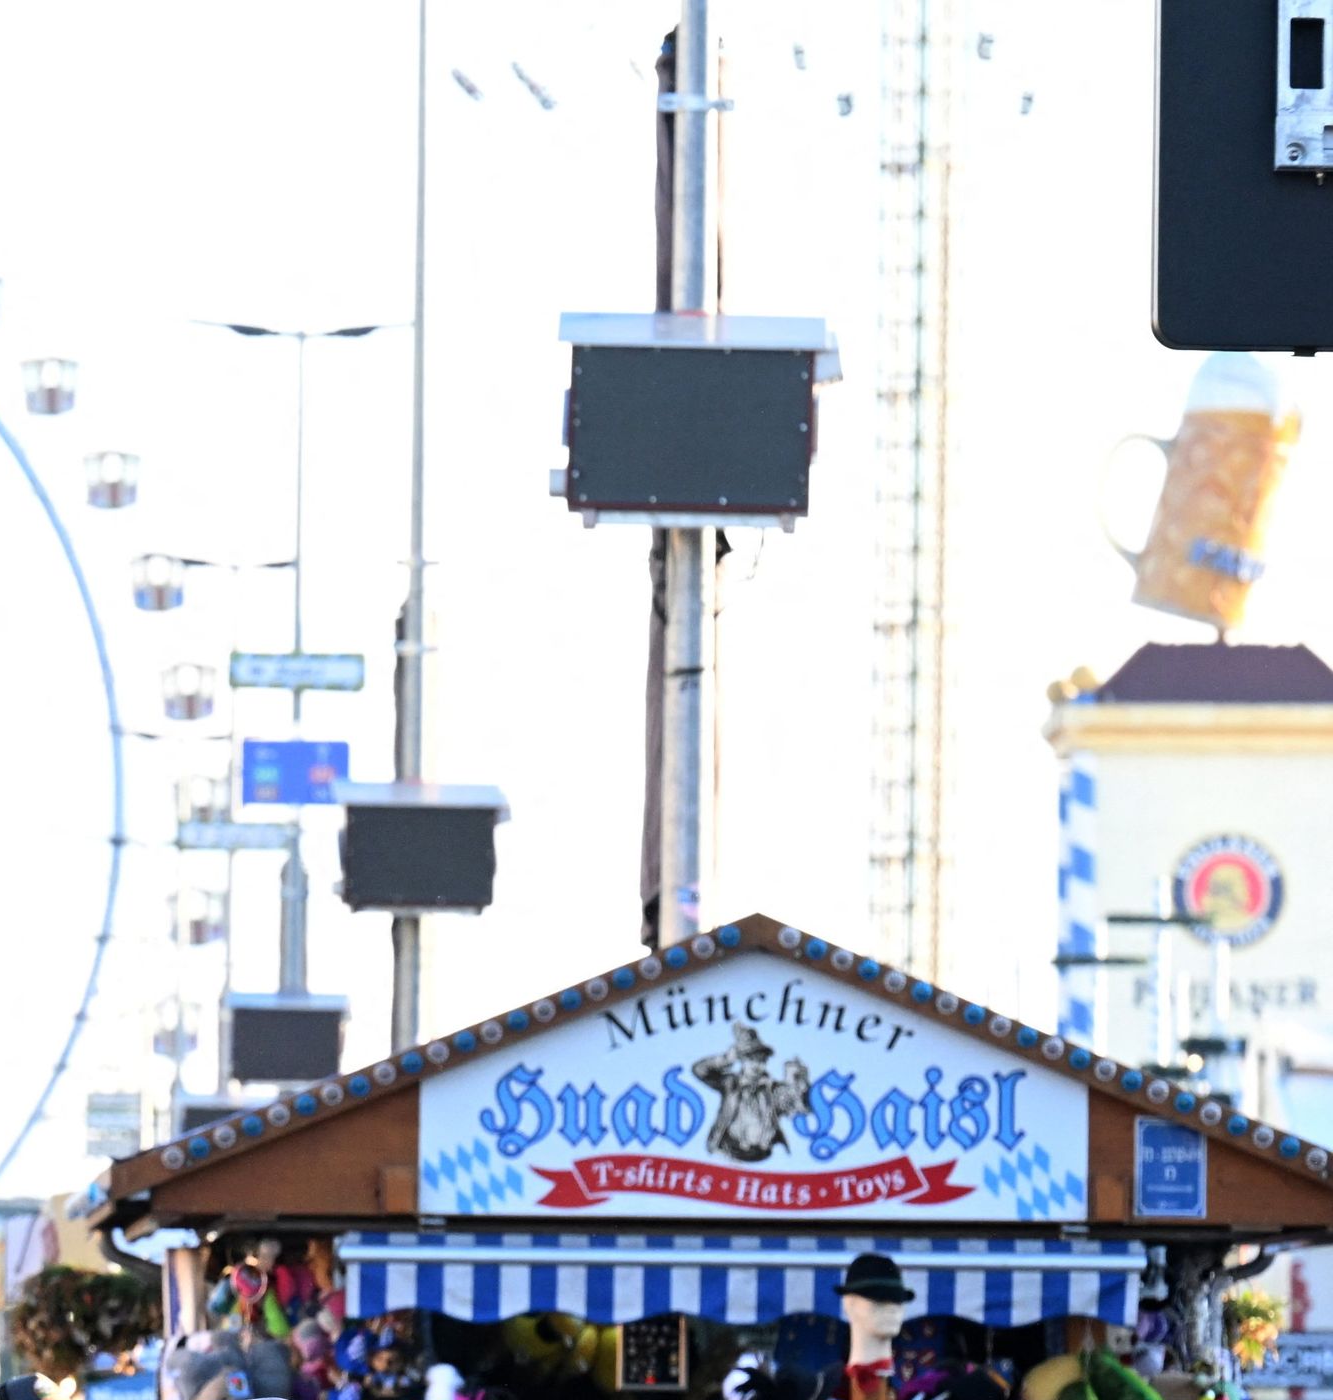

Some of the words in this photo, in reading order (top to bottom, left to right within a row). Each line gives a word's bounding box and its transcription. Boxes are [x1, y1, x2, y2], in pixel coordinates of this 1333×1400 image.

[601, 978, 916, 1051] Münchner
[592, 1160, 712, 1194] T-shirts
[736, 1176, 812, 1206] Hats
[834, 1166, 906, 1203] Toys
